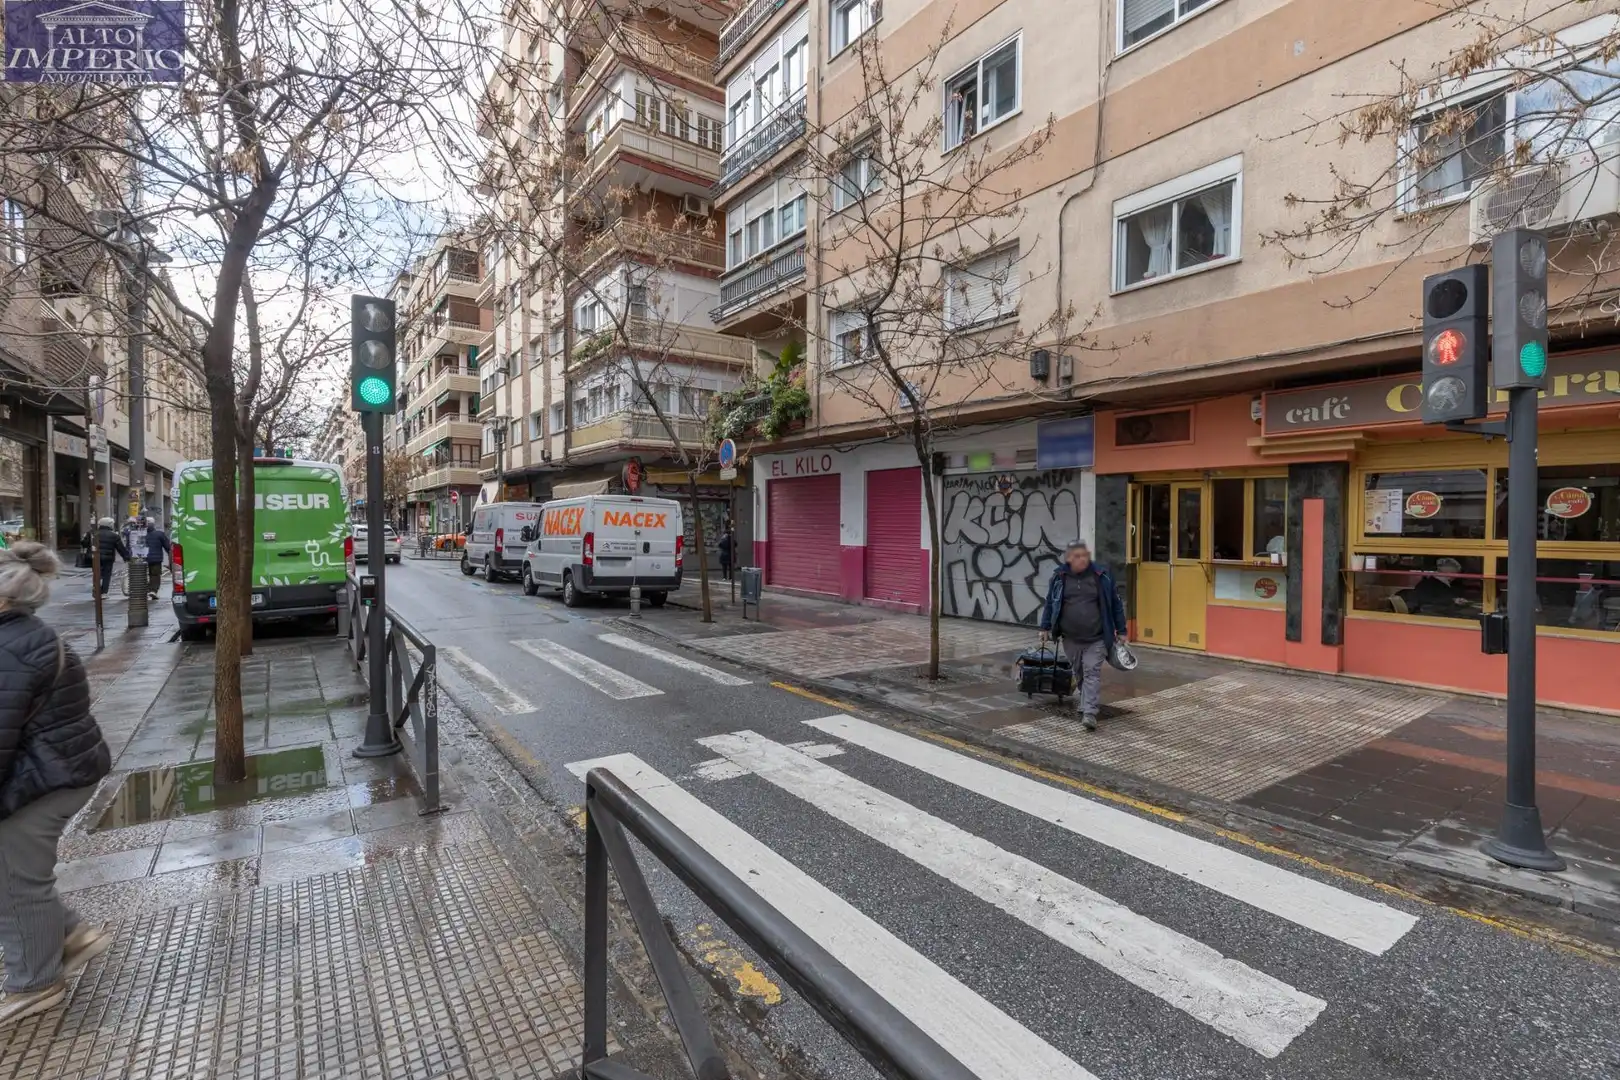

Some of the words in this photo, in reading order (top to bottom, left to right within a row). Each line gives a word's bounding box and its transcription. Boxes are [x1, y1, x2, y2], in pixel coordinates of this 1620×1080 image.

[1285, 396, 1351, 424] café
[772, 460, 788, 477] EL
[795, 454, 832, 475] KILO
[266, 493, 330, 510] SEUR
[544, 507, 584, 536] NACEX
[603, 510, 667, 528] NACEX
